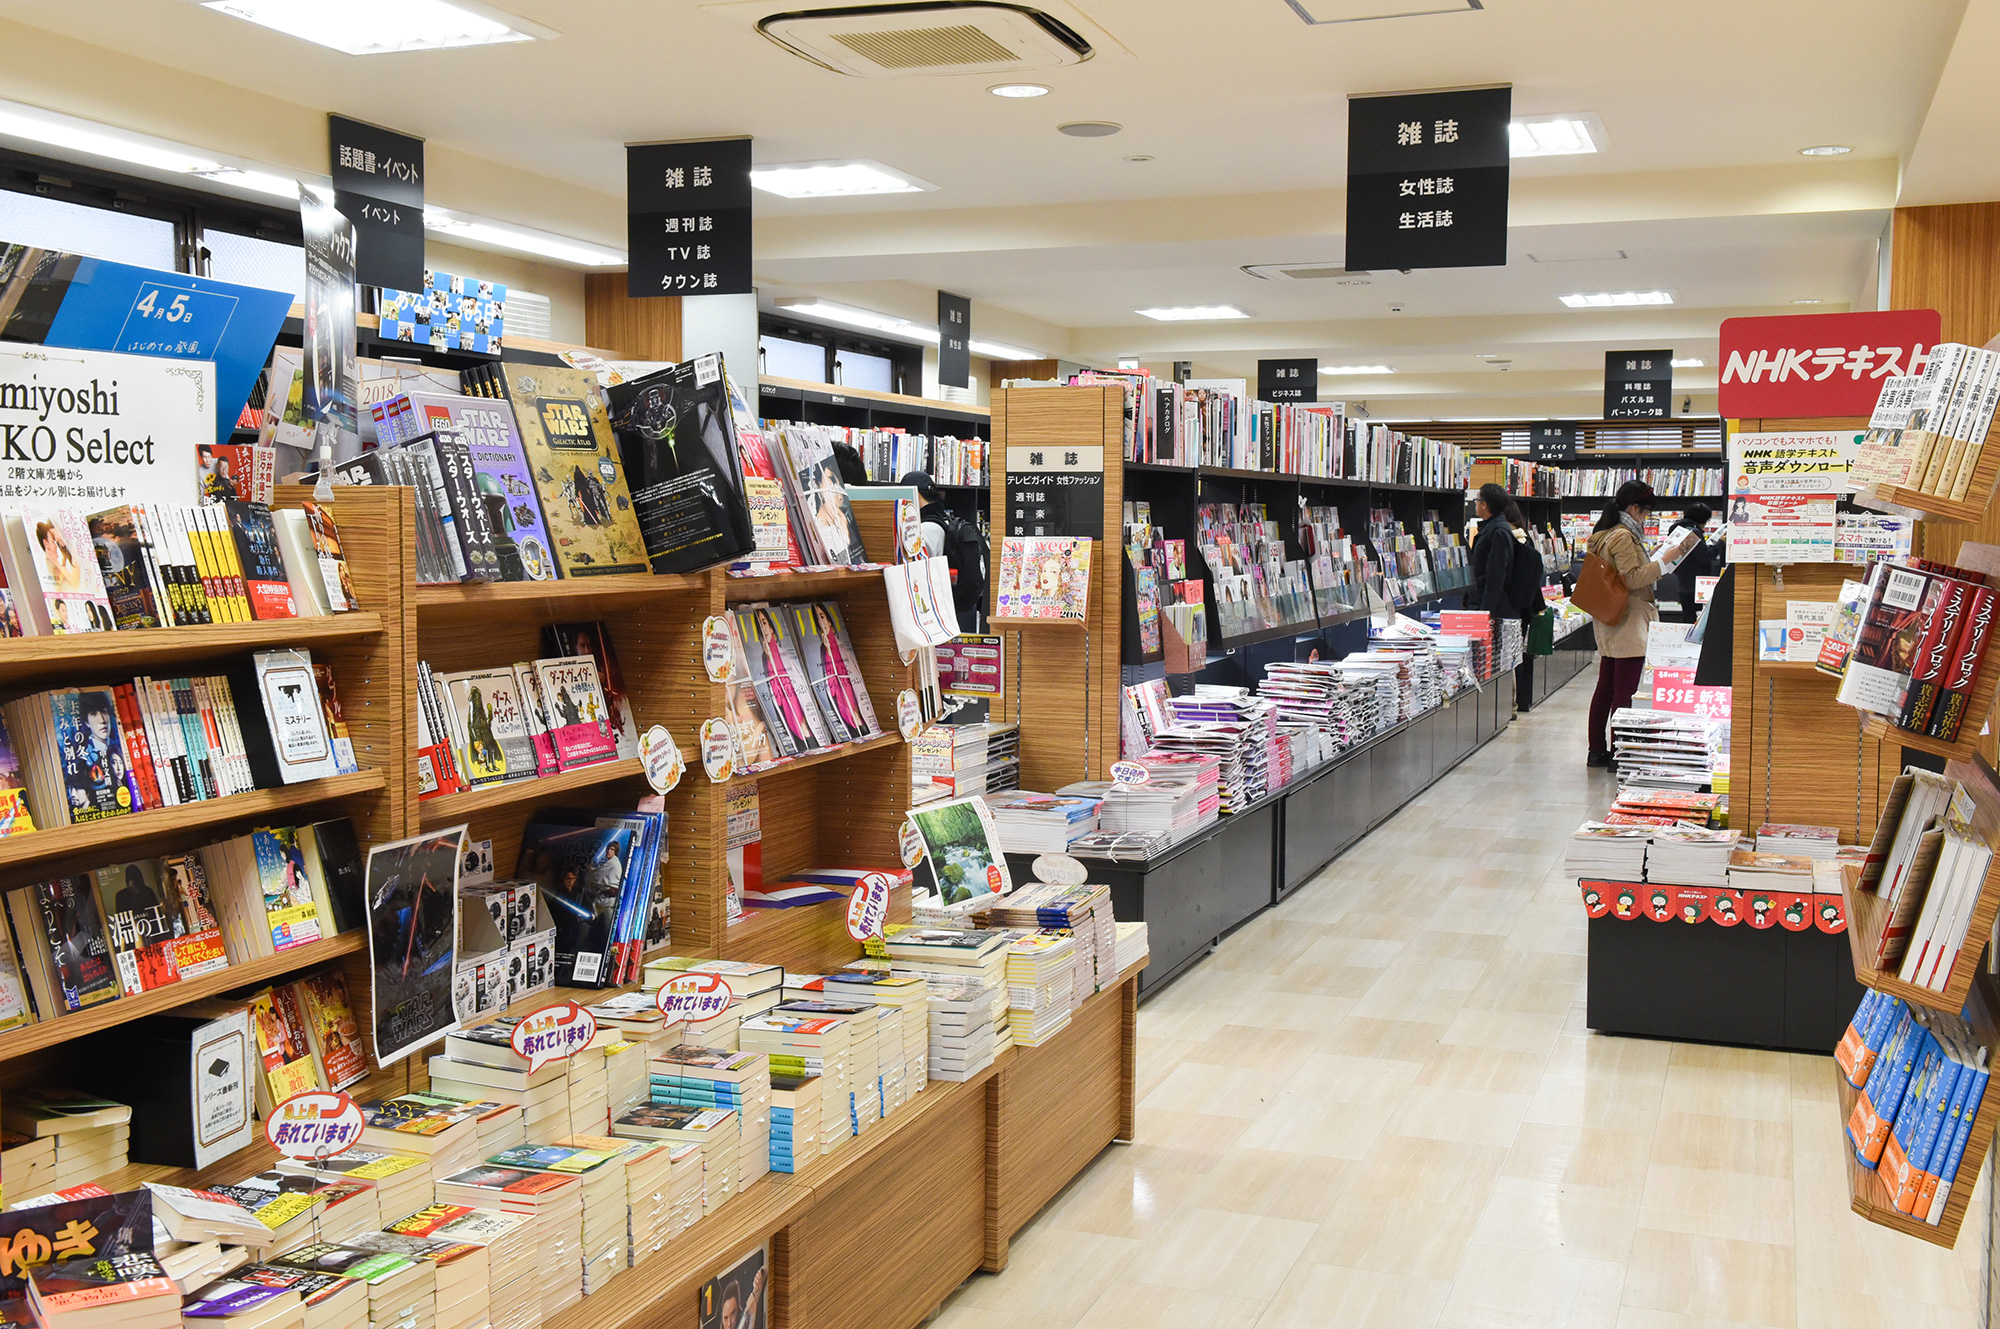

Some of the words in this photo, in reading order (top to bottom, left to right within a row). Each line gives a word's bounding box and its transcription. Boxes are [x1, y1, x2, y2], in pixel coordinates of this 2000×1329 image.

[1397, 118, 1459, 146] 雑誌
[340, 143, 419, 185] 話題書・イベント
[665, 165, 713, 188] 雑誌
[1399, 175, 1454, 197] 女性誌
[361, 203, 401, 226] イベント
[664, 215, 713, 233] 週刊誌
[1398, 208, 1454, 229] 生活誌
[660, 272, 718, 289] タウン誌
[136, 289, 193, 323] 4月5日
[394, 289, 495, 325] あなたと365日
[1626, 360, 1652, 370] 雑誌
[1721, 343, 1932, 384] NHKテキスト
[1949, 346, 1962, 377] 医者が教える
[1964, 350, 1977, 380] 医者が教える
[1978, 353, 1991, 384] 医者が教える
[1276, 368, 1299, 378] 雑誌
[0, 373, 120, 422] miyoshi
[364, 384, 394, 405] 2018
[1272, 390, 1302, 398] ビジネス誌
[1624, 383, 1651, 391] 料理誌
[1937, 377, 1954, 404] 食事術
[1952, 380, 1968, 407] 食事術
[1967, 384, 1983, 411] 食事術
[1621, 396, 1654, 404] パズル誌
[1982, 387, 1999, 415] 食事術
[431, 417, 450, 429] LEGO
[456, 407, 508, 429] STAR
[542, 403, 585, 422] STAR
[1611, 408, 1663, 417] パートワーク誌
[544, 418, 589, 437] WARS
[1544, 428, 1562, 436] 雑誌
[0, 425, 56, 463] KO
[66, 428, 155, 465] Select
[552, 437, 577, 446] GALACTIC
[578, 437, 591, 446] ATLAS
[1737, 436, 1837, 445] パソコンでもスマホでも!
[478, 452, 516, 463] DICTIONARY
[1030, 451, 1078, 465] 雑誌
[1744, 450, 1772, 459] NHK
[1775, 449, 1837, 459] 語学テキスト
[7, 467, 84, 481] 2階文庫売場から
[1743, 459, 1854, 475] 音声ダウンロード
[1007, 476, 1054, 485] テレビガイド
[1056, 475, 1100, 485] 女性ファッション
[445, 453, 479, 545] スター・ウォーズ
[460, 455, 491, 545] スター・ウォーズ
[1015, 492, 1045, 502] 週刊誌
[1015, 509, 1045, 519] 音楽
[1015, 526, 1044, 536] 映画
[1837, 534, 1892, 544] スマホで聞ける!
[1797, 614, 1825, 622] 現代英語
[1920, 587, 1964, 681] ミステリークロック
[1952, 595, 1995, 689] ミステリークロック
[1826, 640, 1846, 653] このミス
[549, 667, 592, 685] ダース・ヴェイダー
[570, 682, 595, 694] と仲間たち
[1656, 688, 1694, 703] ESSE
[1700, 689, 1727, 704] 新年
[493, 706, 519, 723] ヴェイダー
[1694, 703, 1731, 716] 特大号
[1909, 683, 1933, 730] 貴志祐介
[1938, 692, 1963, 739] 貴志祐介
[69, 699, 90, 762] 去年の冬
[285, 715, 311, 725] ミステリー
[1114, 766, 1146, 779] 本日発売
[858, 874, 886, 938] 売れています!
[107, 902, 170, 948] 淵の王
[391, 991, 434, 1024] STAR
[663, 996, 727, 1012] 売れています!
[391, 1009, 435, 1043] WARS
[523, 1015, 556, 1035] 急上昇
[523, 1022, 591, 1056] 売れています!
[204, 1081, 239, 1103] シリーズ最新刊
[283, 1103, 319, 1120] 急上昇
[274, 1122, 359, 1145] 売れています!
[1917, 1115, 1941, 1168] 自律神経の整え方
[1931, 1121, 1955, 1174] 自律神経の整え方
[1944, 1126, 1968, 1179] 自律神経の整え方
[704, 1285, 713, 1317] 1
